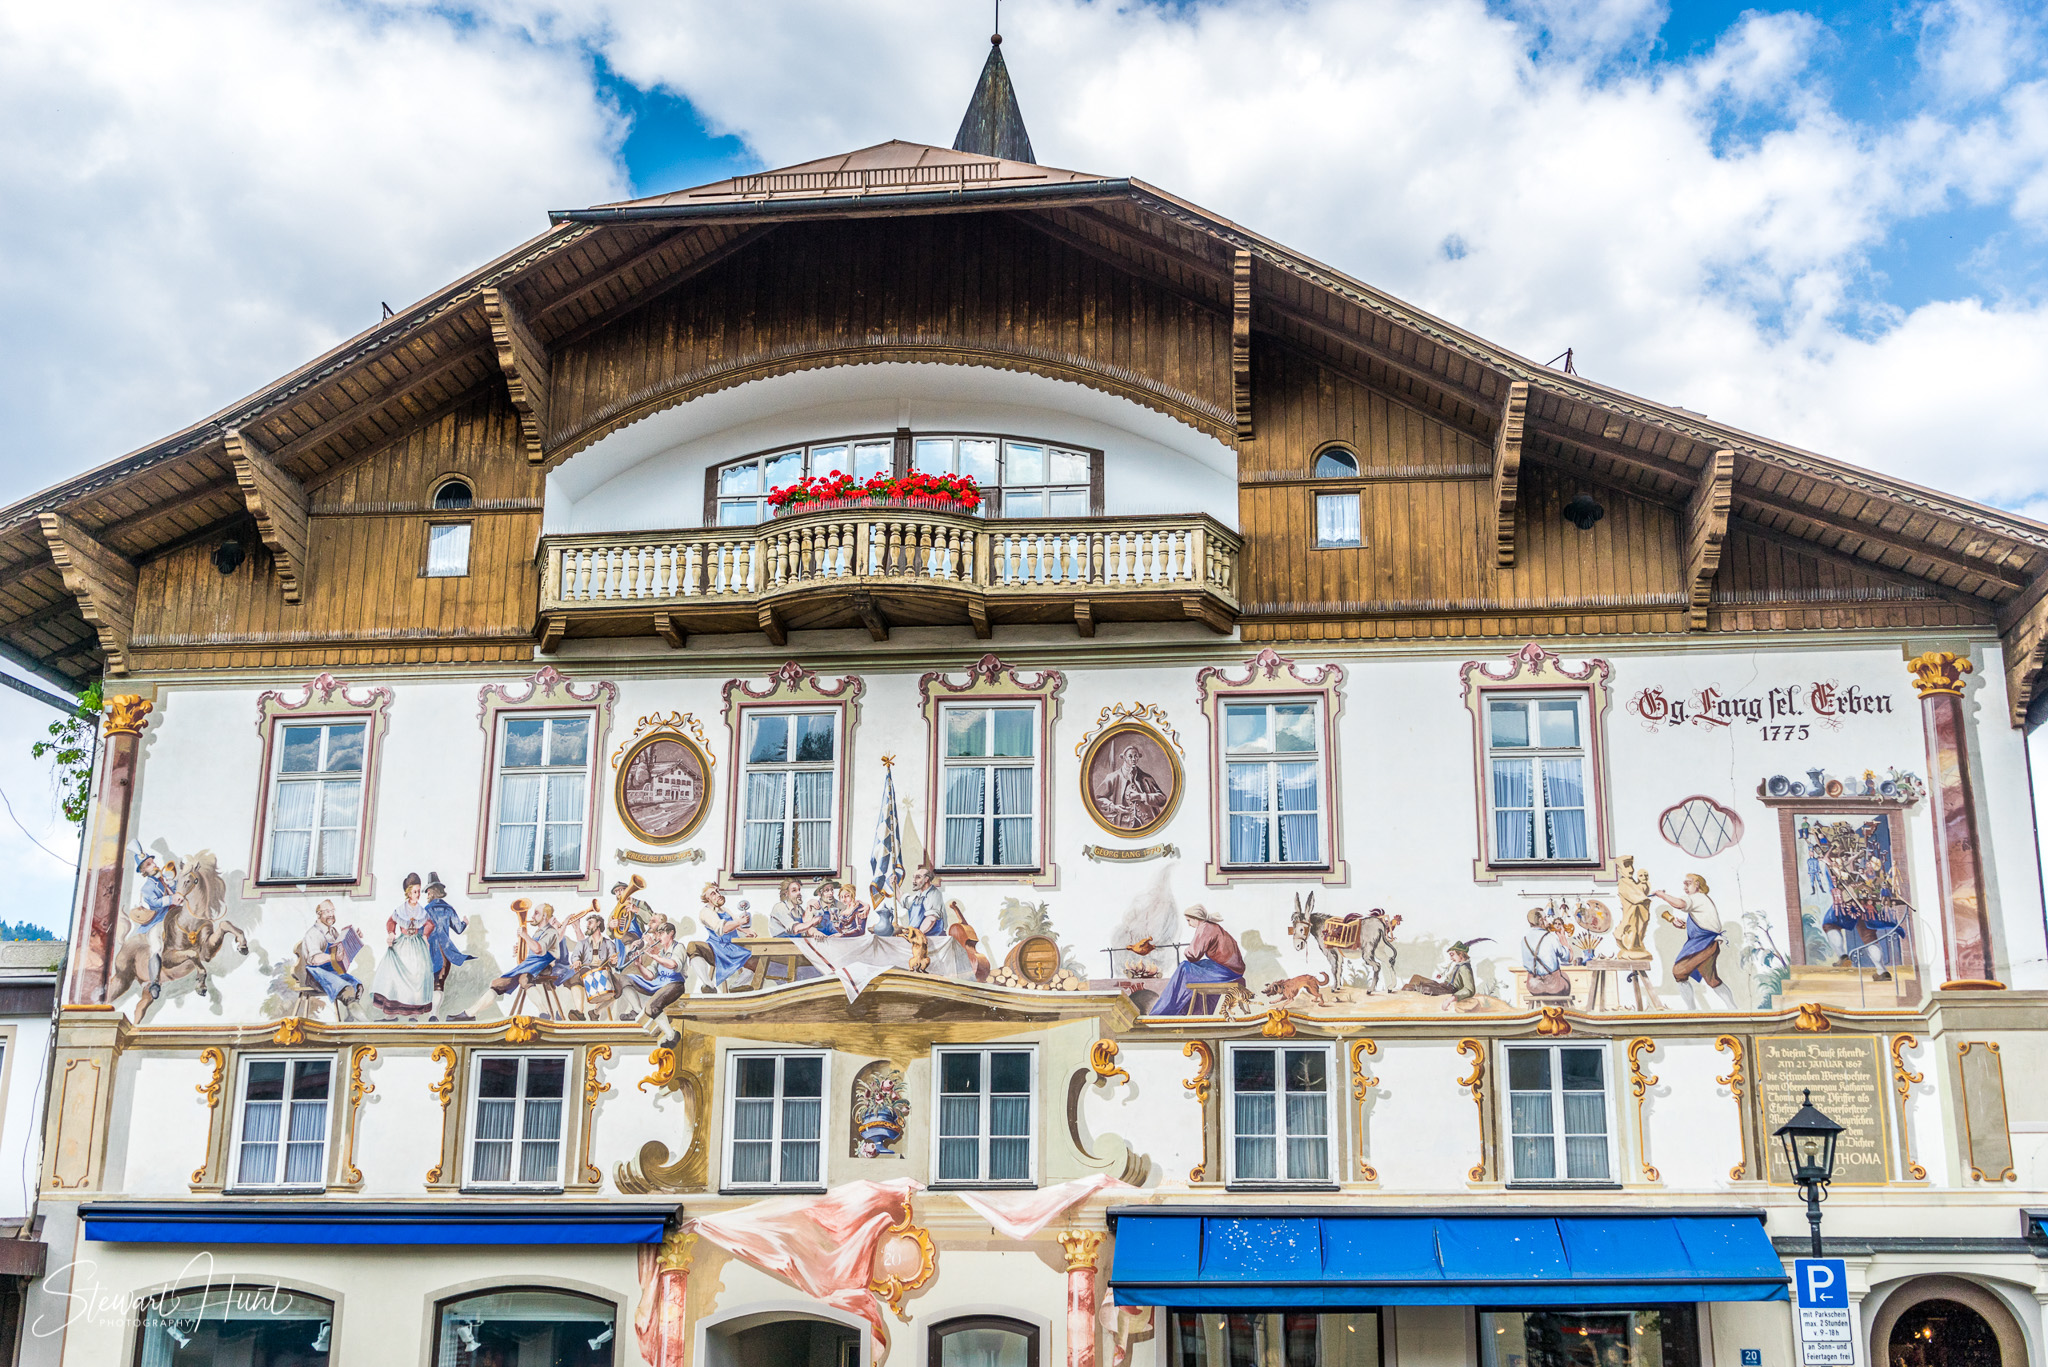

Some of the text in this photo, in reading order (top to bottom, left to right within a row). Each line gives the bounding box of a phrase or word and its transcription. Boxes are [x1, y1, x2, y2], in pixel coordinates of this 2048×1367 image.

[1760, 725, 1810, 741] 1775
[1094, 847, 1118, 858] GEORG
[1121, 850, 1141, 858] LANG
[1809, 1061, 1844, 1069] JANUAR
[1767, 1072, 1777, 1081] die
[1767, 1083, 1780, 1091] von
[1840, 1081, 1875, 1092] Katharina
[1768, 1092, 1794, 1102] Thoma
[1858, 1093, 1870, 1102] als
[1848, 1127, 1864, 1136] dem
[1835, 1152, 1881, 1165] THOMA
[883, 1252, 902, 1266] 20
[1807, 1265, 1835, 1303] P
[1745, 1351, 1758, 1360] 20
[1807, 1353, 1838, 1361] Feiertagen
